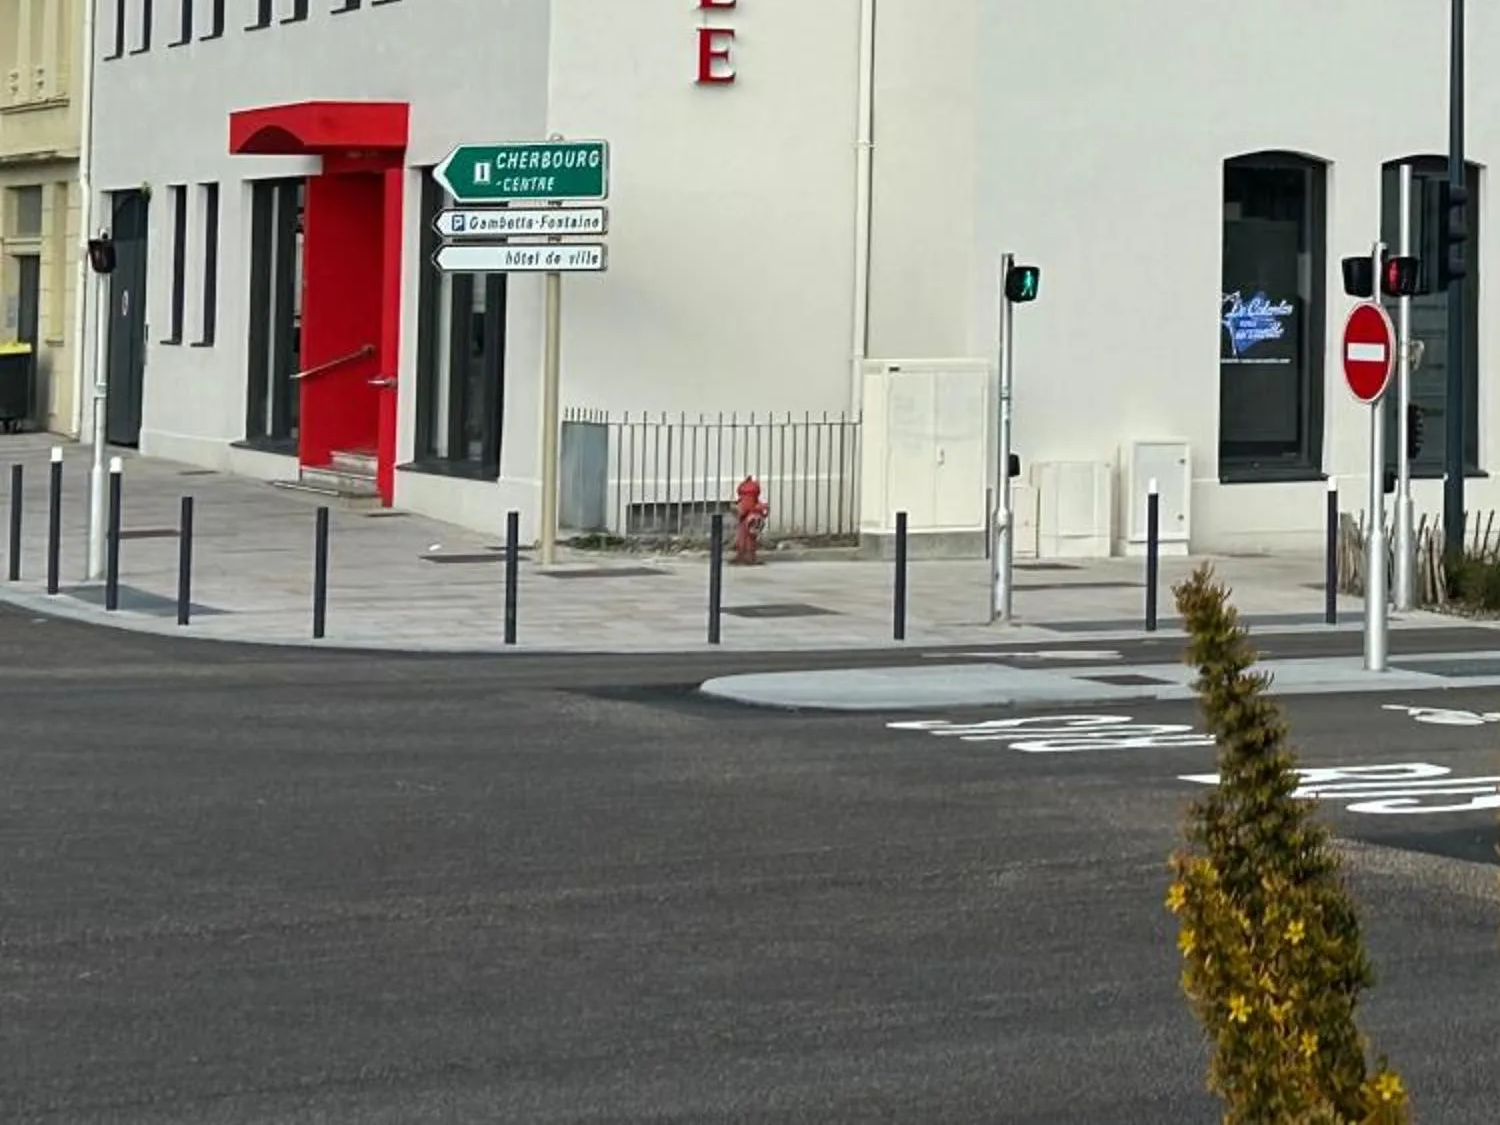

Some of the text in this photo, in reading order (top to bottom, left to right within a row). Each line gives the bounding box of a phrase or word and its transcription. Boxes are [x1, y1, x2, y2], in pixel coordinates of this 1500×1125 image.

[495, 149, 600, 170] CHERBOURG
[505, 249, 599, 266] hôtel de ville
